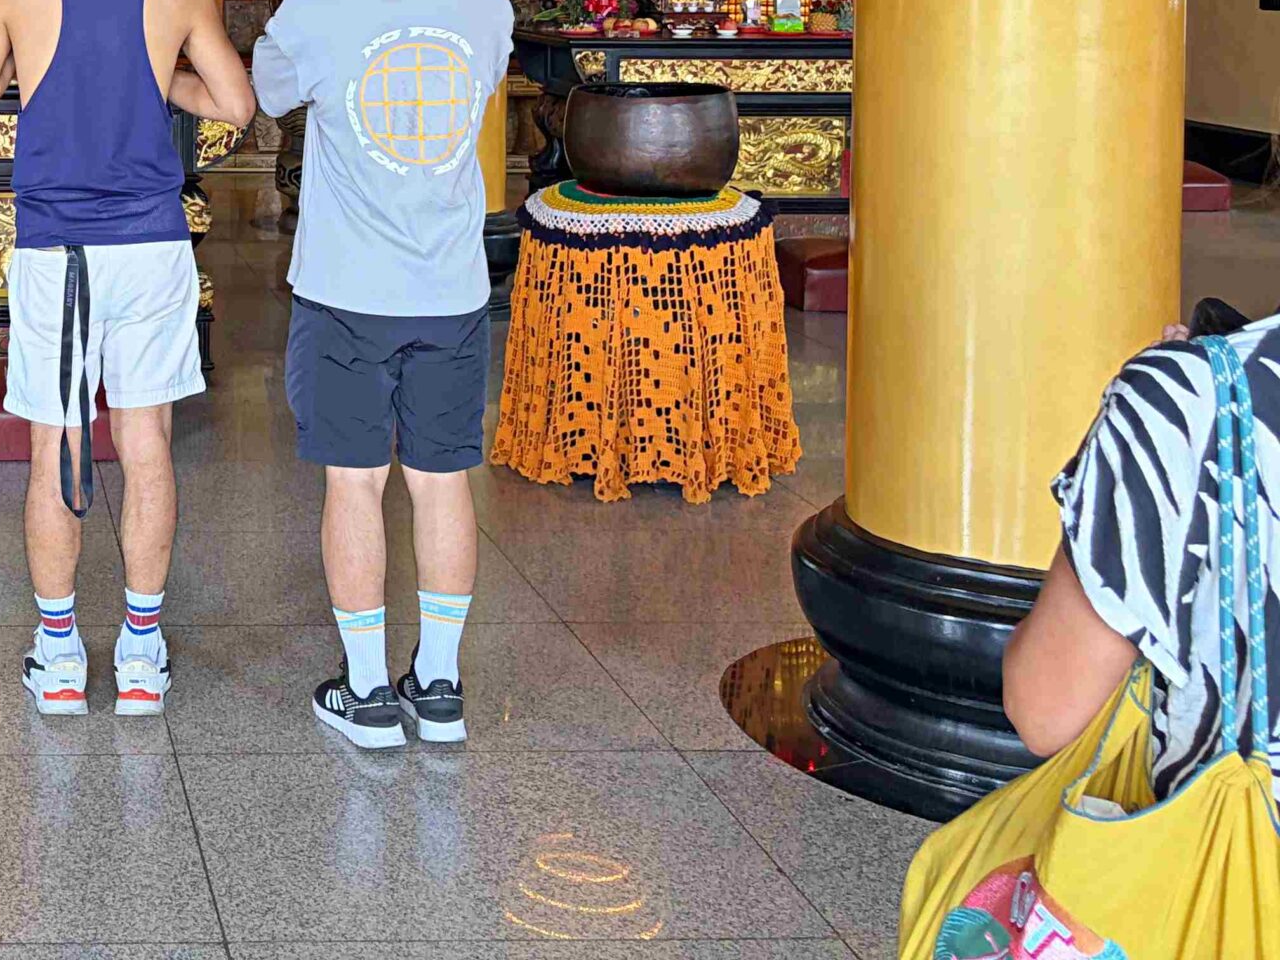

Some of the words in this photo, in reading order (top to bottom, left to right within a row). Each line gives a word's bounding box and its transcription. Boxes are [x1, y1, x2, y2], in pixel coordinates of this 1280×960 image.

[362, 29, 402, 58] NO
[408, 27, 473, 58] FEAR
[367, 149, 409, 175] NO
